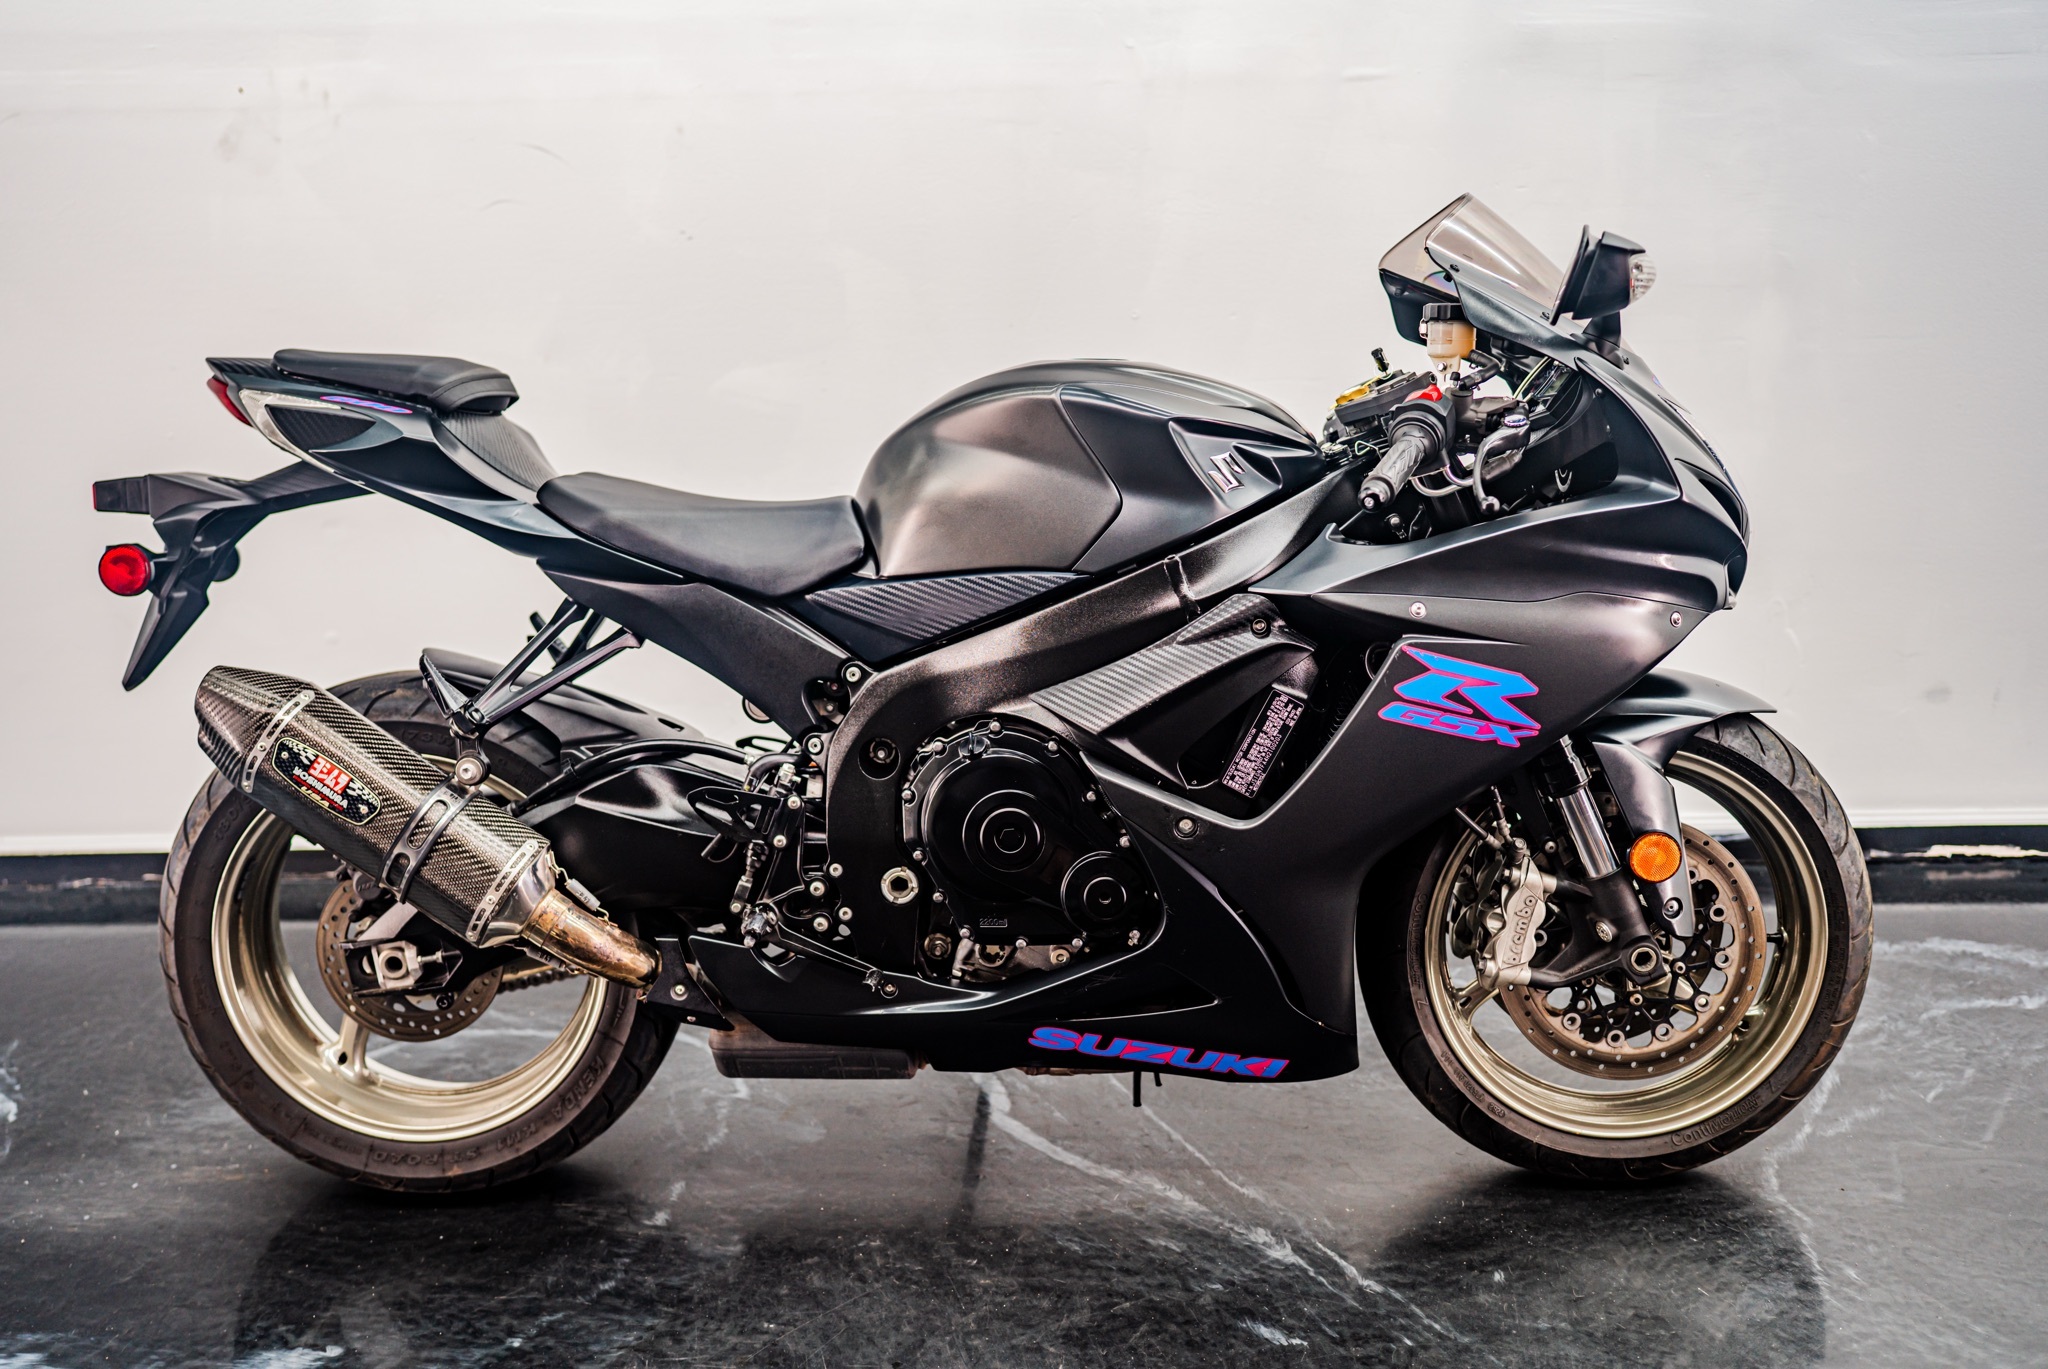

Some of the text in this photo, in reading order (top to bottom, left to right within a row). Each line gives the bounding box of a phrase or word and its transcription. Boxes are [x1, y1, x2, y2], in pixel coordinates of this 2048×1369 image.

[1377, 701, 1540, 748] GSX
[293, 766, 348, 808] YOSHIMURA
[1502, 895, 1537, 966] brembo
[1028, 1027, 1290, 1078] SUZUKI
[551, 1055, 605, 1120] KENDA
[373, 1151, 438, 1165] ROAD
